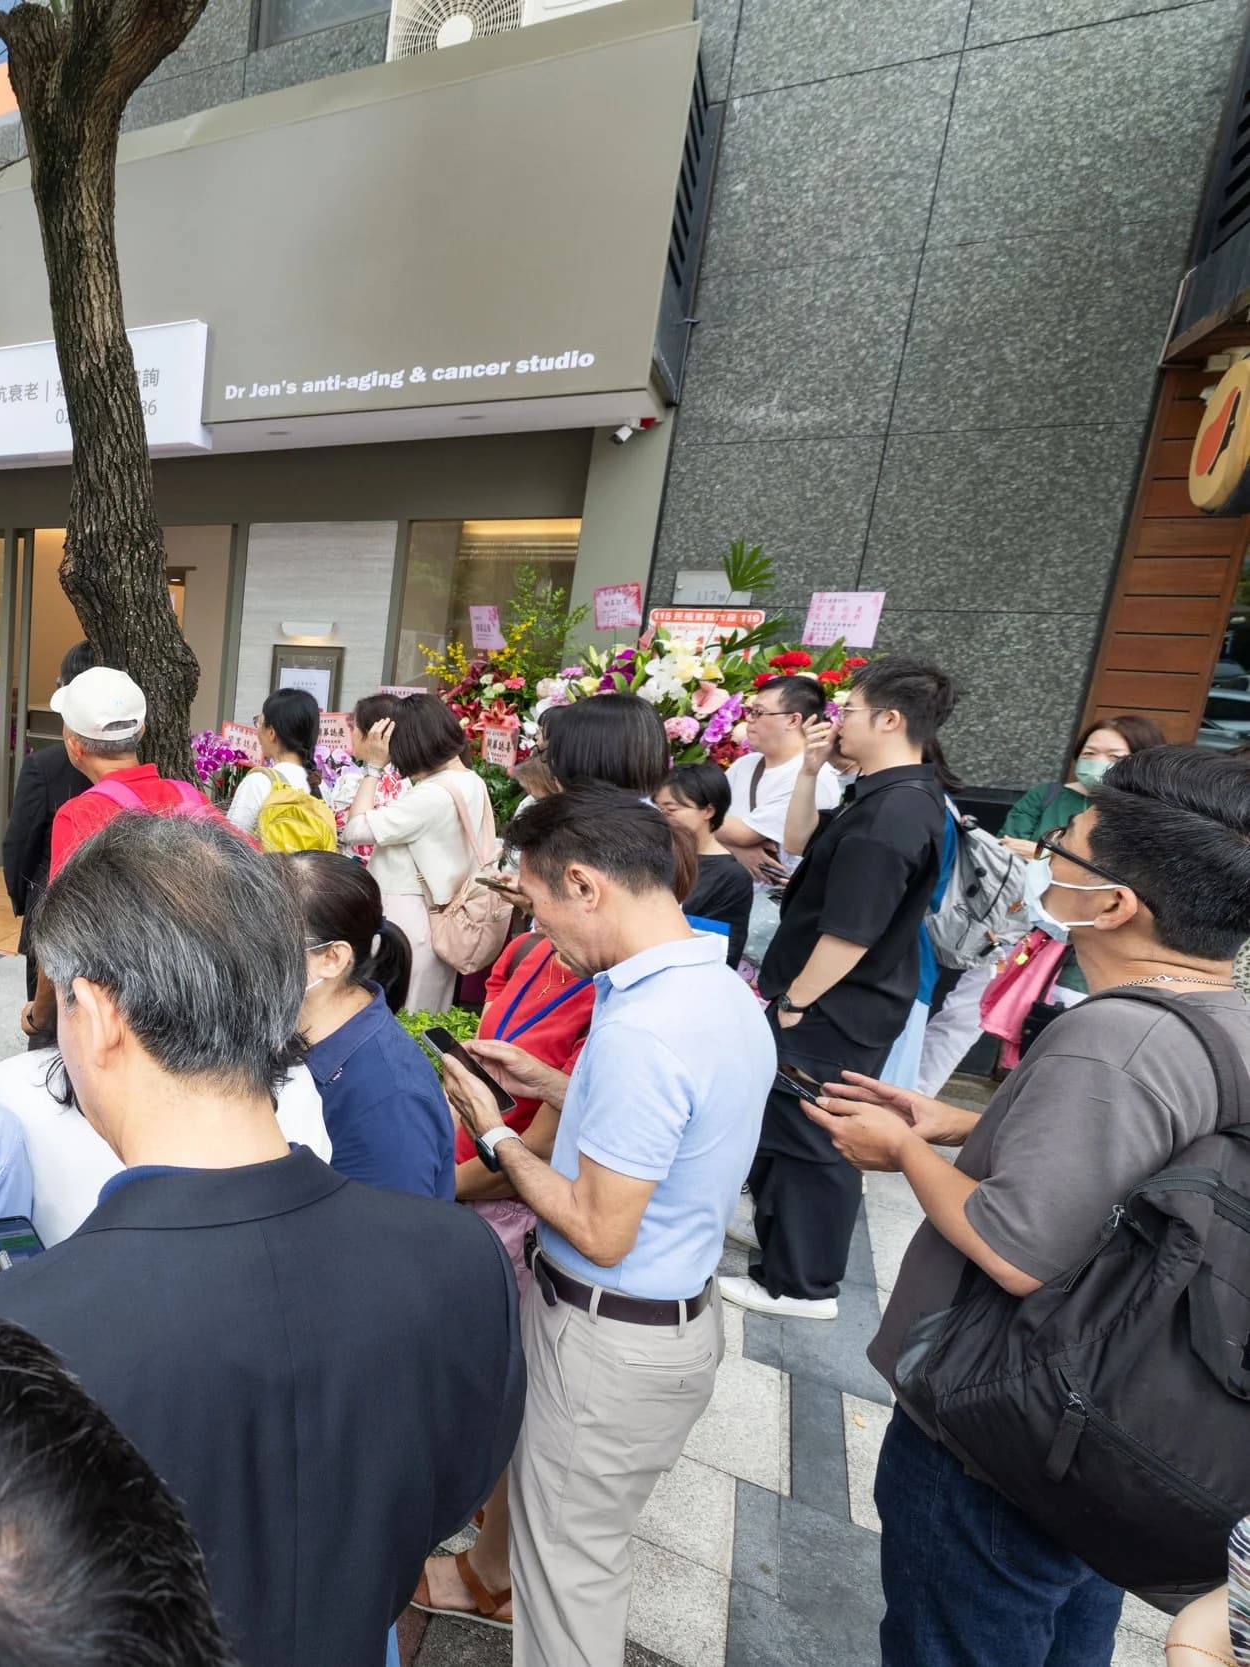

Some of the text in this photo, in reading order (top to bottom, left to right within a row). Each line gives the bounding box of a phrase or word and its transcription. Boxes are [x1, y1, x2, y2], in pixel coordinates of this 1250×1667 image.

[225, 350, 595, 400] Dr Jen's anti-aging & cancer studio
[654, 611, 672, 620] 115
[740, 613, 760, 622] 119
